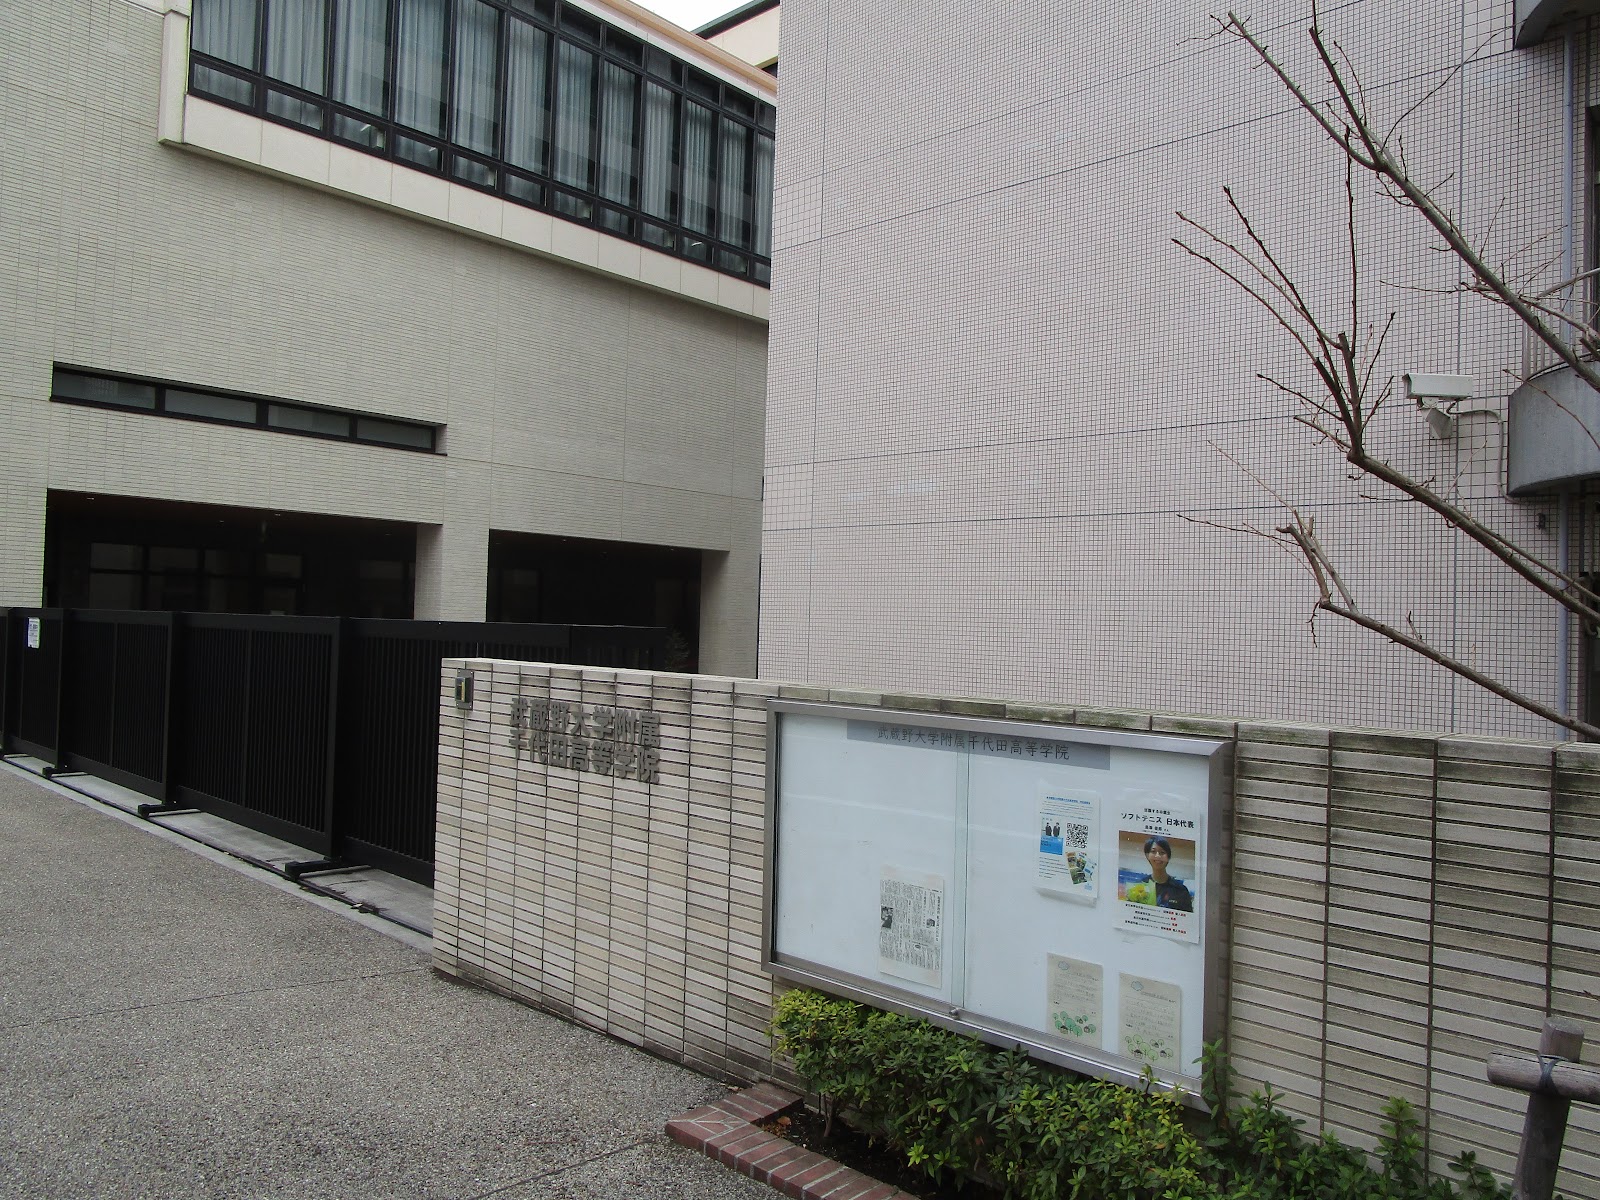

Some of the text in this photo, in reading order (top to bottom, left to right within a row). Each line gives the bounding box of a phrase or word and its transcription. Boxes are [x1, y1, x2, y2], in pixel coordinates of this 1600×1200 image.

[509, 697, 661, 749] 武蔵野大学附属
[508, 728, 661, 785] 千代田高等学院
[1121, 812, 1163, 824] ソフトテニス
[1166, 818, 1195, 829] 日本代表
